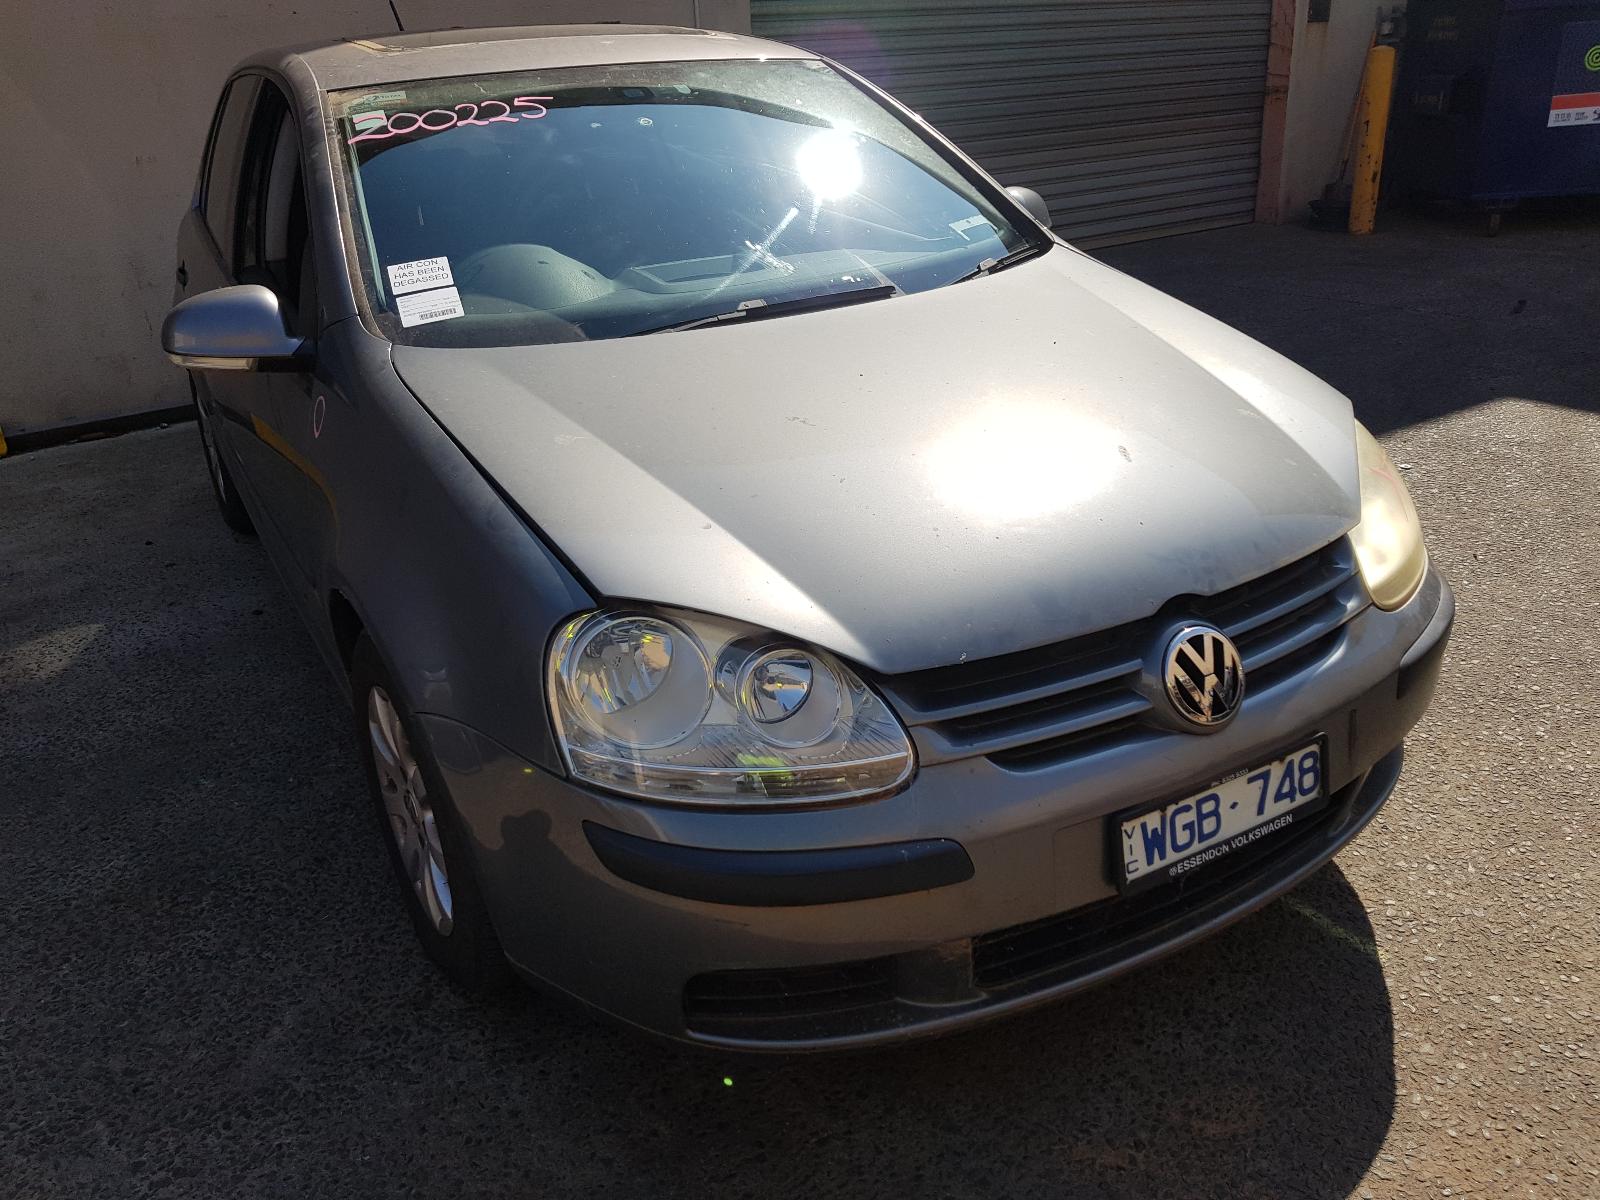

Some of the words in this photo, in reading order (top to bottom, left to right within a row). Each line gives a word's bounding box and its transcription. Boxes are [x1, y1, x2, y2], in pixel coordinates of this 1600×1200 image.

[348, 96, 554, 145] 200225
[393, 272, 449, 288] DEGASSED
[394, 270, 415, 280] HAS
[417, 265, 445, 276] BEEN
[396, 263, 414, 272] AIR
[416, 259, 439, 268] CON
[1124, 825, 1139, 875] VIC
[1177, 843, 1230, 874] ESSENDON
[1230, 813, 1294, 850] VOLKSWAGEN
